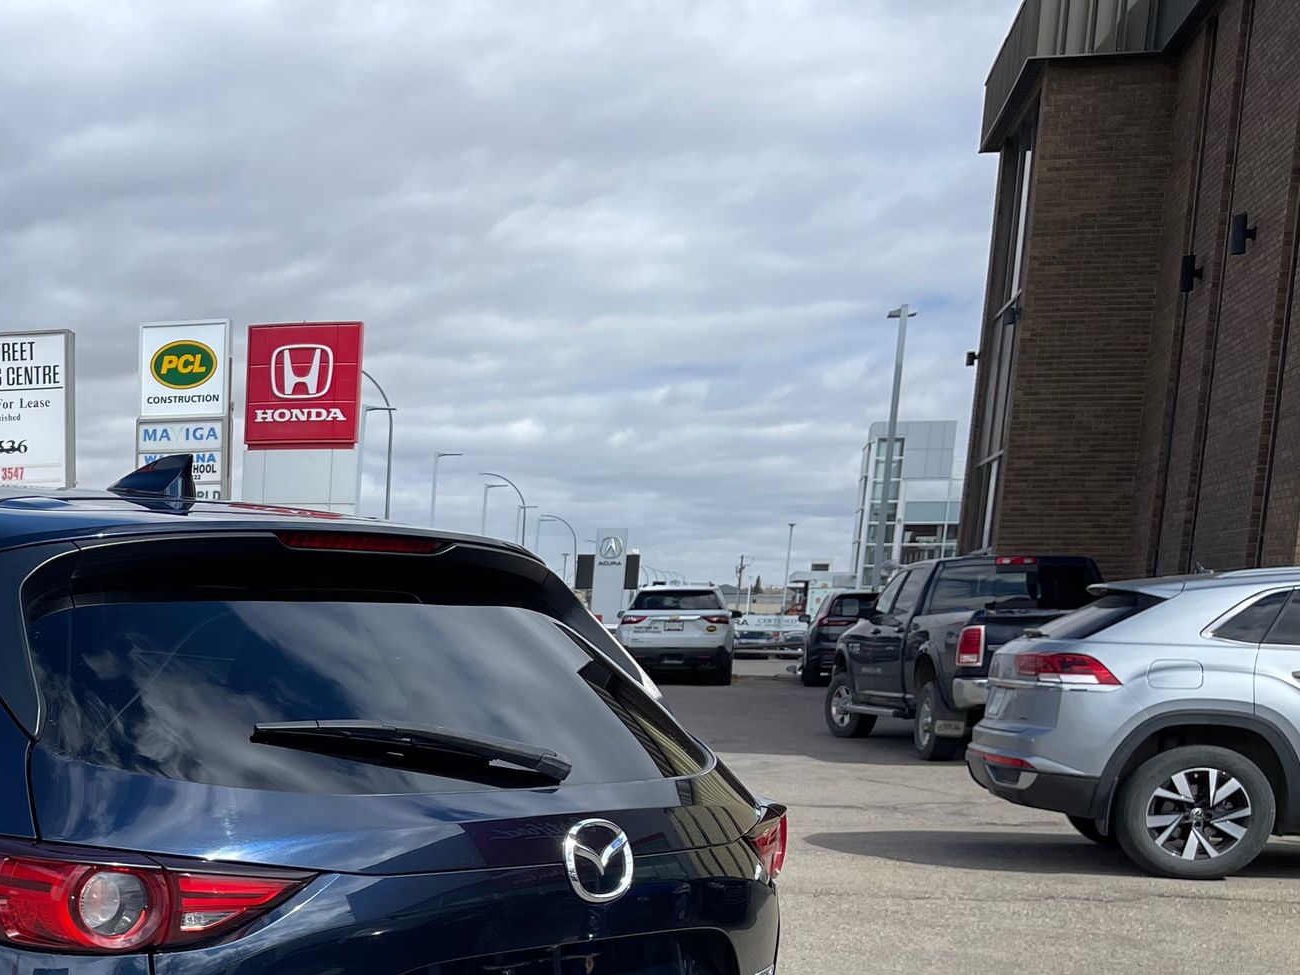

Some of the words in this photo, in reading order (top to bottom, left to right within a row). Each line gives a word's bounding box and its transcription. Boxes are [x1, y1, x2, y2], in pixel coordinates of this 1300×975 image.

[161, 354, 206, 375] PCL
[6, 364, 60, 386] CENTRE
[19, 397, 51, 409] Lease
[146, 394, 220, 405] CONSTRUCTION
[254, 408, 347, 423] HONDA
[1, 466, 25, 480] 3547
